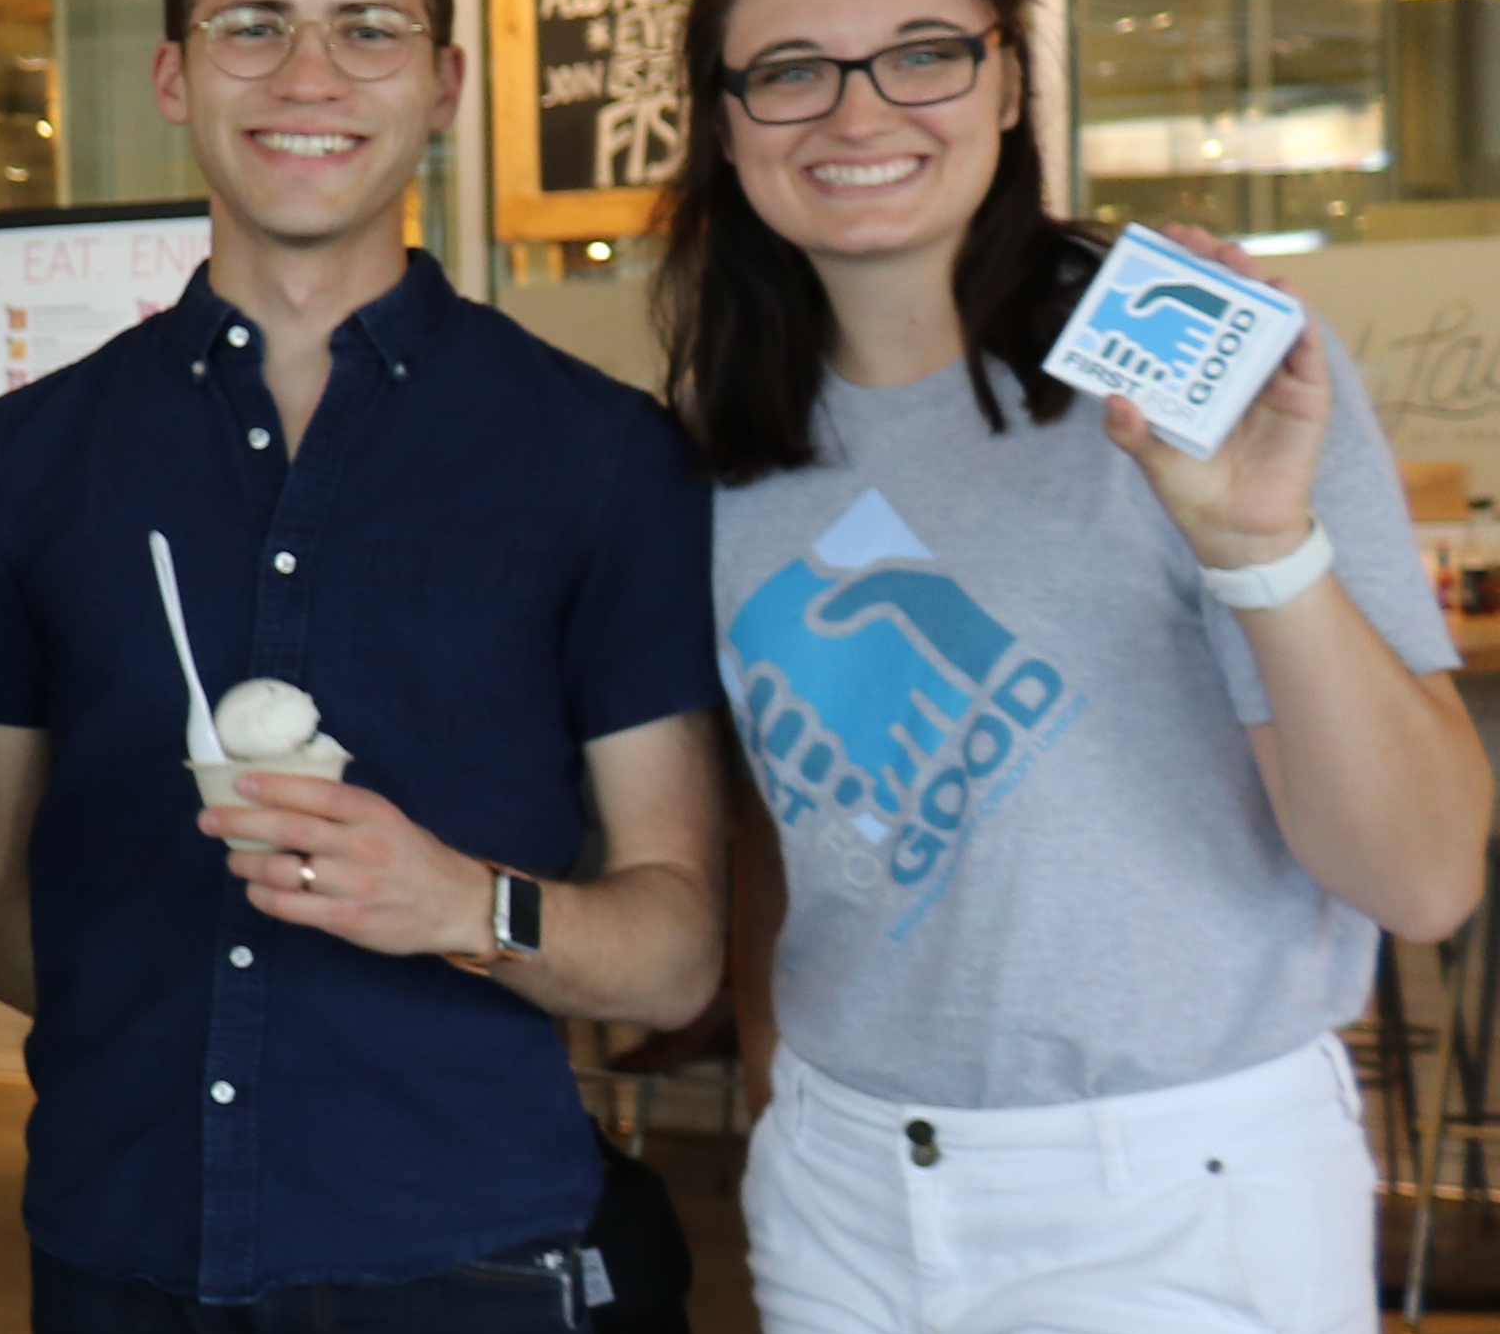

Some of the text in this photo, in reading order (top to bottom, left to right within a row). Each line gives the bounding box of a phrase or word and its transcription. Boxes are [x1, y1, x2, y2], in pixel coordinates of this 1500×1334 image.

[596, 91, 689, 187] FIS
[1062, 349, 1145, 396] FIRST
[1187, 308, 1255, 405] GOOD
[890, 658, 1065, 886] GOOD
